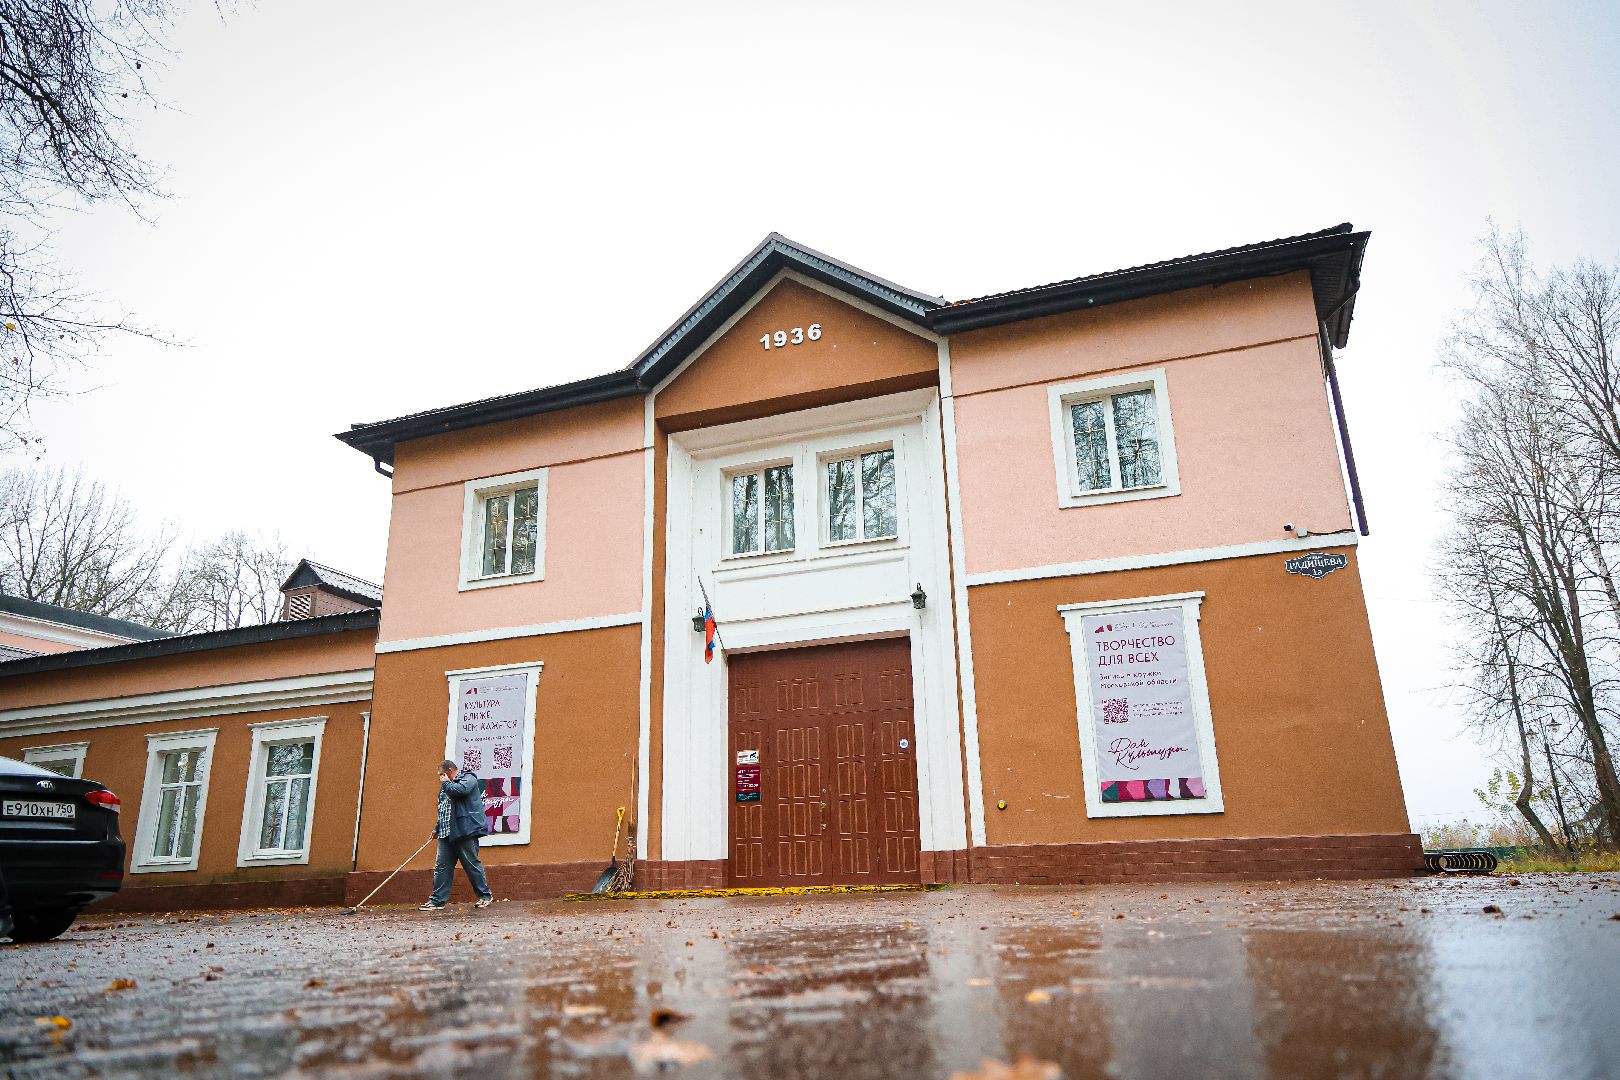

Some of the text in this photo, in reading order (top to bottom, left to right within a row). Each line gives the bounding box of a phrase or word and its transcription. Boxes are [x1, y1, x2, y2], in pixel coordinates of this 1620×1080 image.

[760, 323, 822, 350] 1936
[1289, 557, 1343, 571] РАДИЩЕВА
[1096, 635, 1176, 651] ТВОРЧЕСТВО
[1098, 651, 1160, 667] ДЛЯ ВСЕХ
[464, 699, 501, 710] КУЛЬТУРА
[462, 719, 518, 732] ЧЕМ КАЖЕТСЯ
[1107, 737, 1150, 754] Дом
[6, 802, 73, 817] Е910ХН 750
